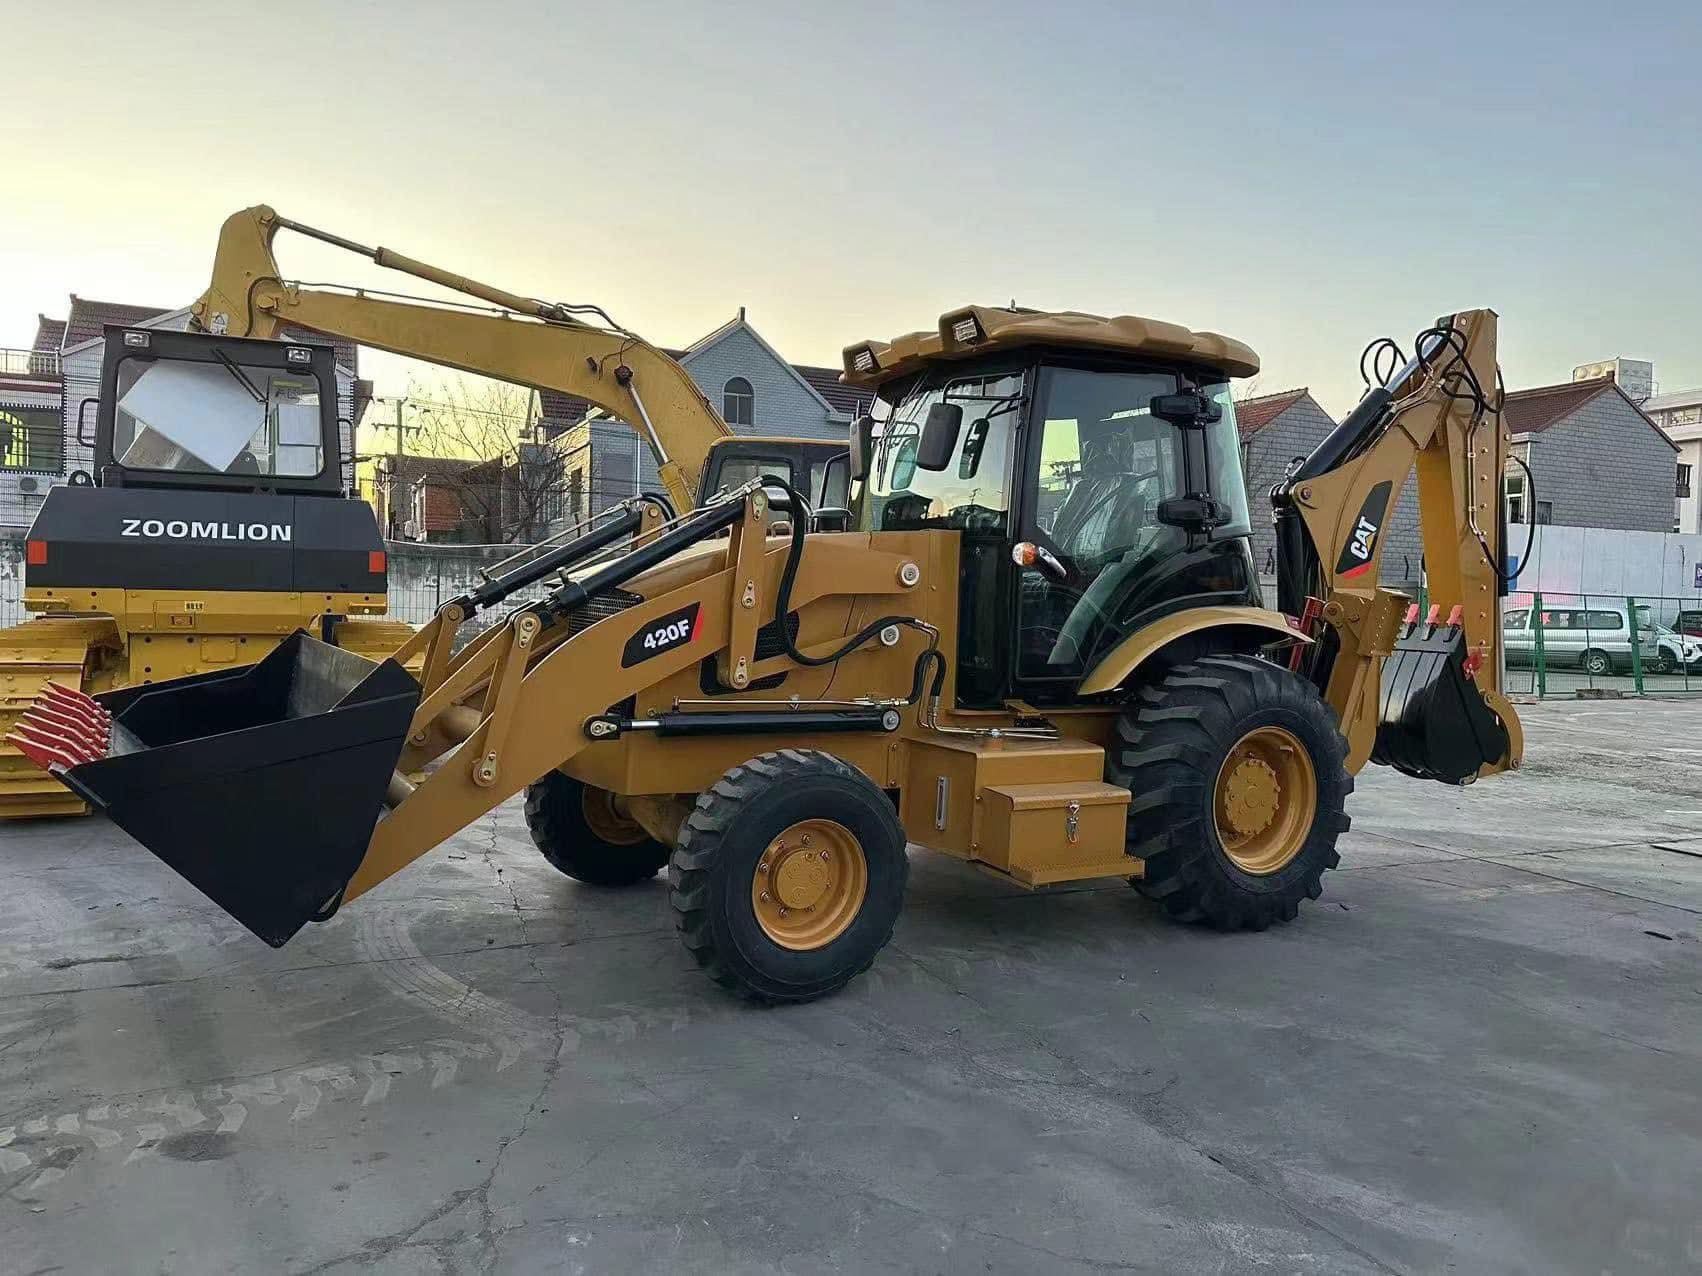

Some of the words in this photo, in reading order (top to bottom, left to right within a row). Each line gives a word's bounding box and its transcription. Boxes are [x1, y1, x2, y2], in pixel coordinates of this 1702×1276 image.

[121, 519, 291, 541] ZOOMLION
[1350, 515, 1377, 559] CAT
[644, 619, 689, 648] 420F
